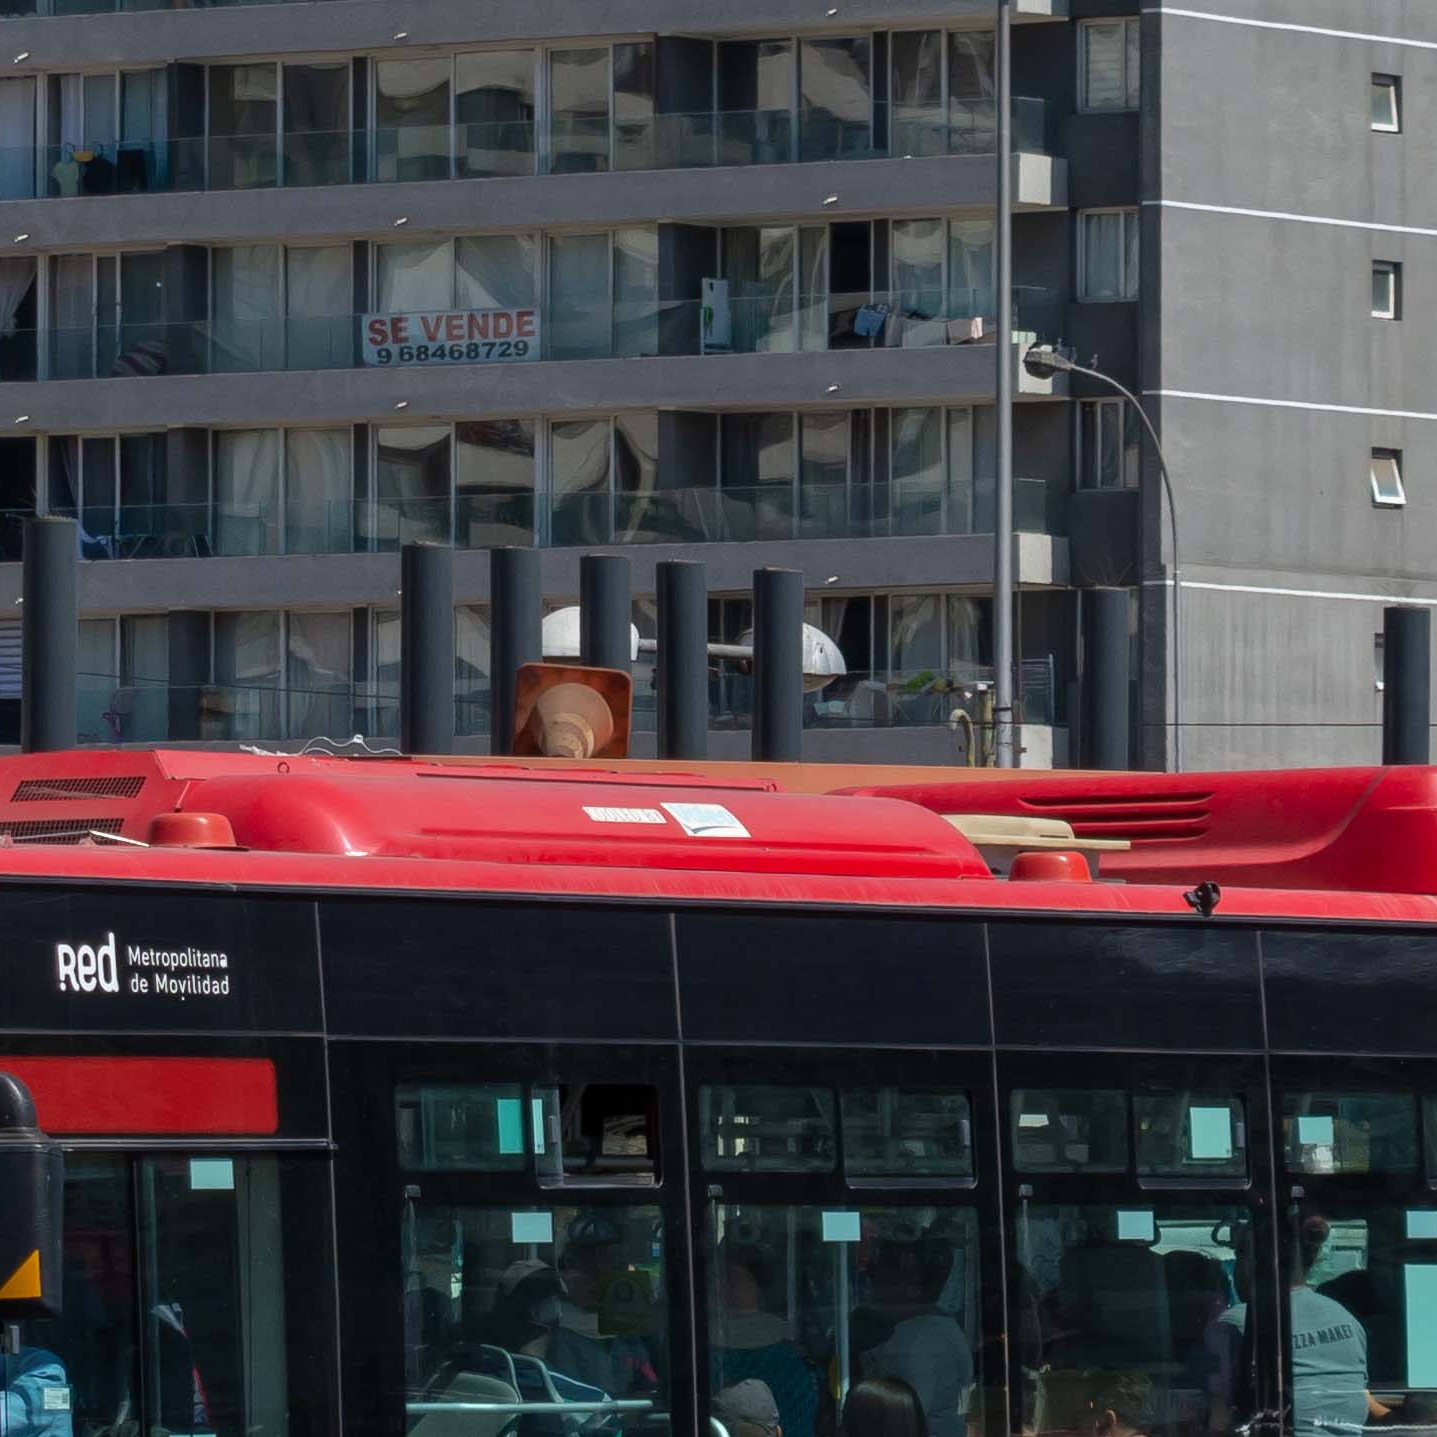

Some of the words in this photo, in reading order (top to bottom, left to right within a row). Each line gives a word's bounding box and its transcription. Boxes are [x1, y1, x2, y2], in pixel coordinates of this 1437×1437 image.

[368, 316, 409, 346] SE
[420, 310, 535, 342] VENDE
[376, 348, 392, 364] 9
[399, 340, 530, 362] 68468729
[57, 931, 119, 993] Red
[127, 945, 228, 971] Metropolitana
[130, 973, 149, 993] de
[155, 974, 230, 994] Movilidad
[1292, 1332, 1316, 1349] ZZA
